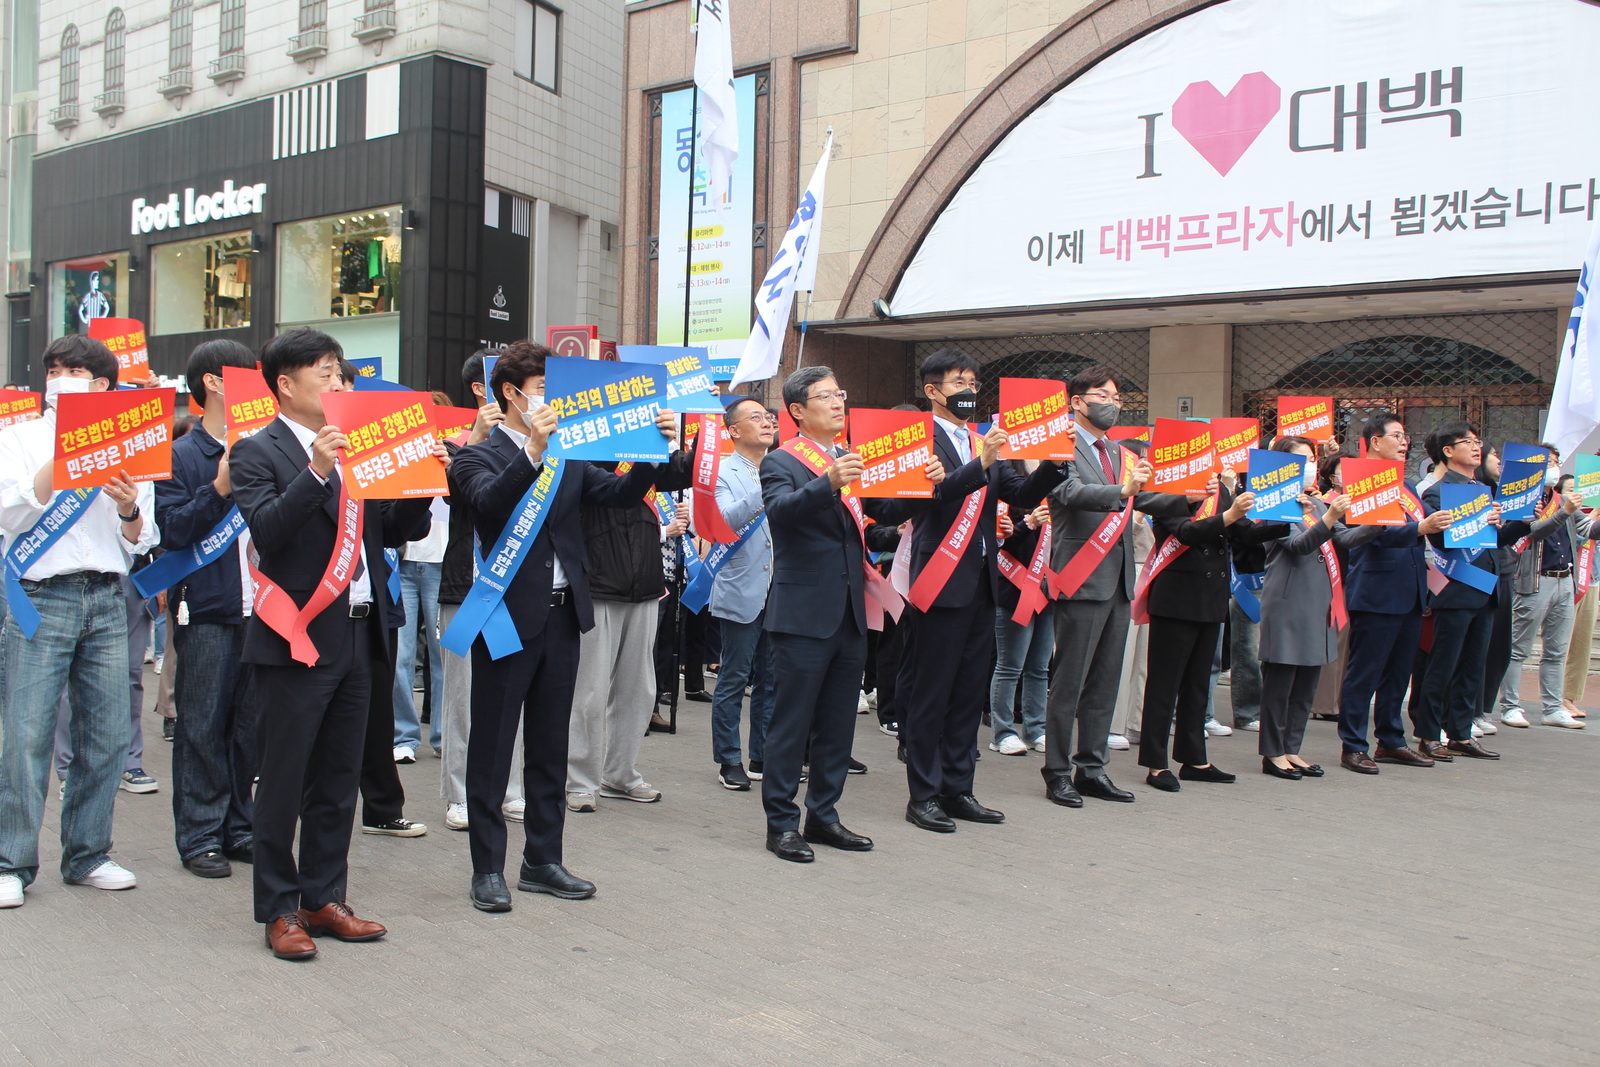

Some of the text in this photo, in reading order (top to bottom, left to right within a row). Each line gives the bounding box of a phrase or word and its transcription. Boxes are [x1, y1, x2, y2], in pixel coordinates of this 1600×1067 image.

[1289, 66, 1464, 153] 대백
[1136, 112, 1164, 180] I
[131, 179, 267, 235] Foot Locker
[1027, 177, 1600, 267] 이제 대백프라자에서 뵙겠습니다
[231, 396, 276, 424] 의료현장
[550, 375, 657, 420] 약소직역 말살하는
[1003, 403, 1043, 429] 간호법안
[1280, 409, 1305, 427] 간호법안
[60, 417, 116, 454] 간호법안
[116, 397, 164, 433] 강행처리
[343, 402, 428, 459] 간호법안 강행처리
[557, 401, 660, 450] 간호협회 규탄한다
[856, 421, 926, 463] 간호법안 강행처리
[1008, 424, 1047, 452] 민주당은
[1215, 432, 1243, 453] 간호법안
[66, 423, 168, 481] 민주당은 자폭하라
[351, 432, 436, 489] 민주당은 자폭하라
[860, 445, 930, 489] 민주당은 자폭하라
[1154, 441, 1188, 464] 의료현장
[1154, 462, 1187, 485] 간호법안
[1251, 469, 1280, 491] 약소직역
[1345, 466, 1398, 499] 무소불위 간호협회
[1501, 478, 1528, 497] 국민건강
[512, 498, 543, 540] 간호법안
[1350, 495, 1376, 518] 의료체계
[13, 525, 50, 564] 결사반대
[490, 536, 523, 578] 결사반대
